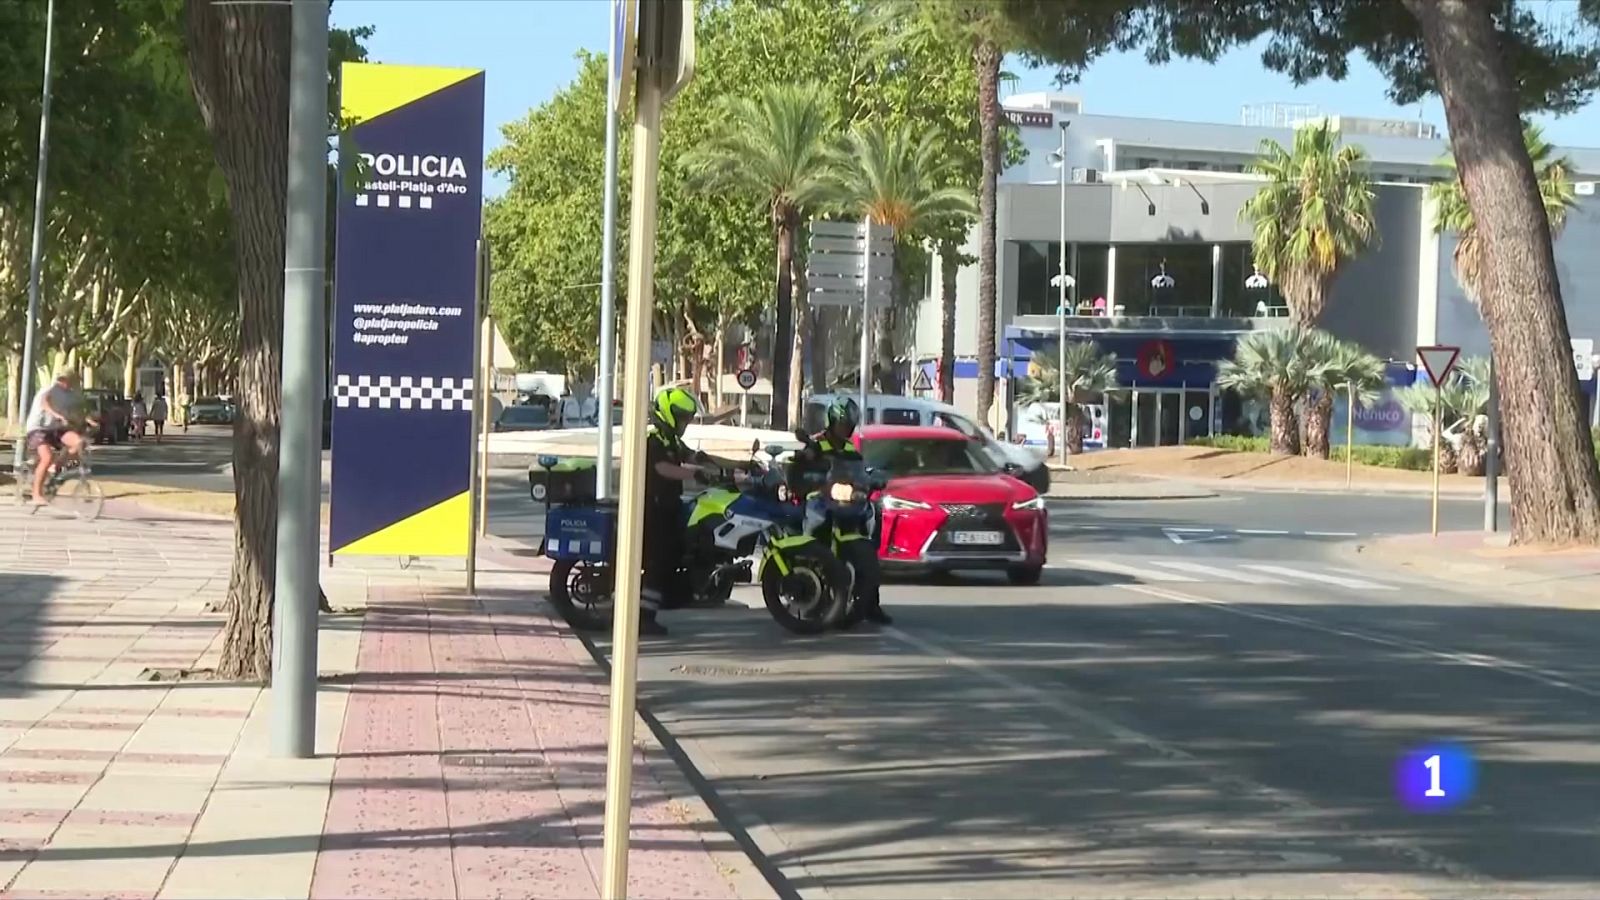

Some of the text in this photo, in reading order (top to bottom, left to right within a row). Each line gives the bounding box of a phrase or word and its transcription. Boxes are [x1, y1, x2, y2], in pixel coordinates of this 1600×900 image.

[357, 153, 467, 178] POLICIA
[356, 179, 467, 194] astell-Platja d'Aro
[353, 303, 462, 317] www.platjadaro.com
[353, 317, 439, 332] @platjaropolicia
[353, 332, 409, 346] #apropteu
[560, 519, 587, 527] POLICIA
